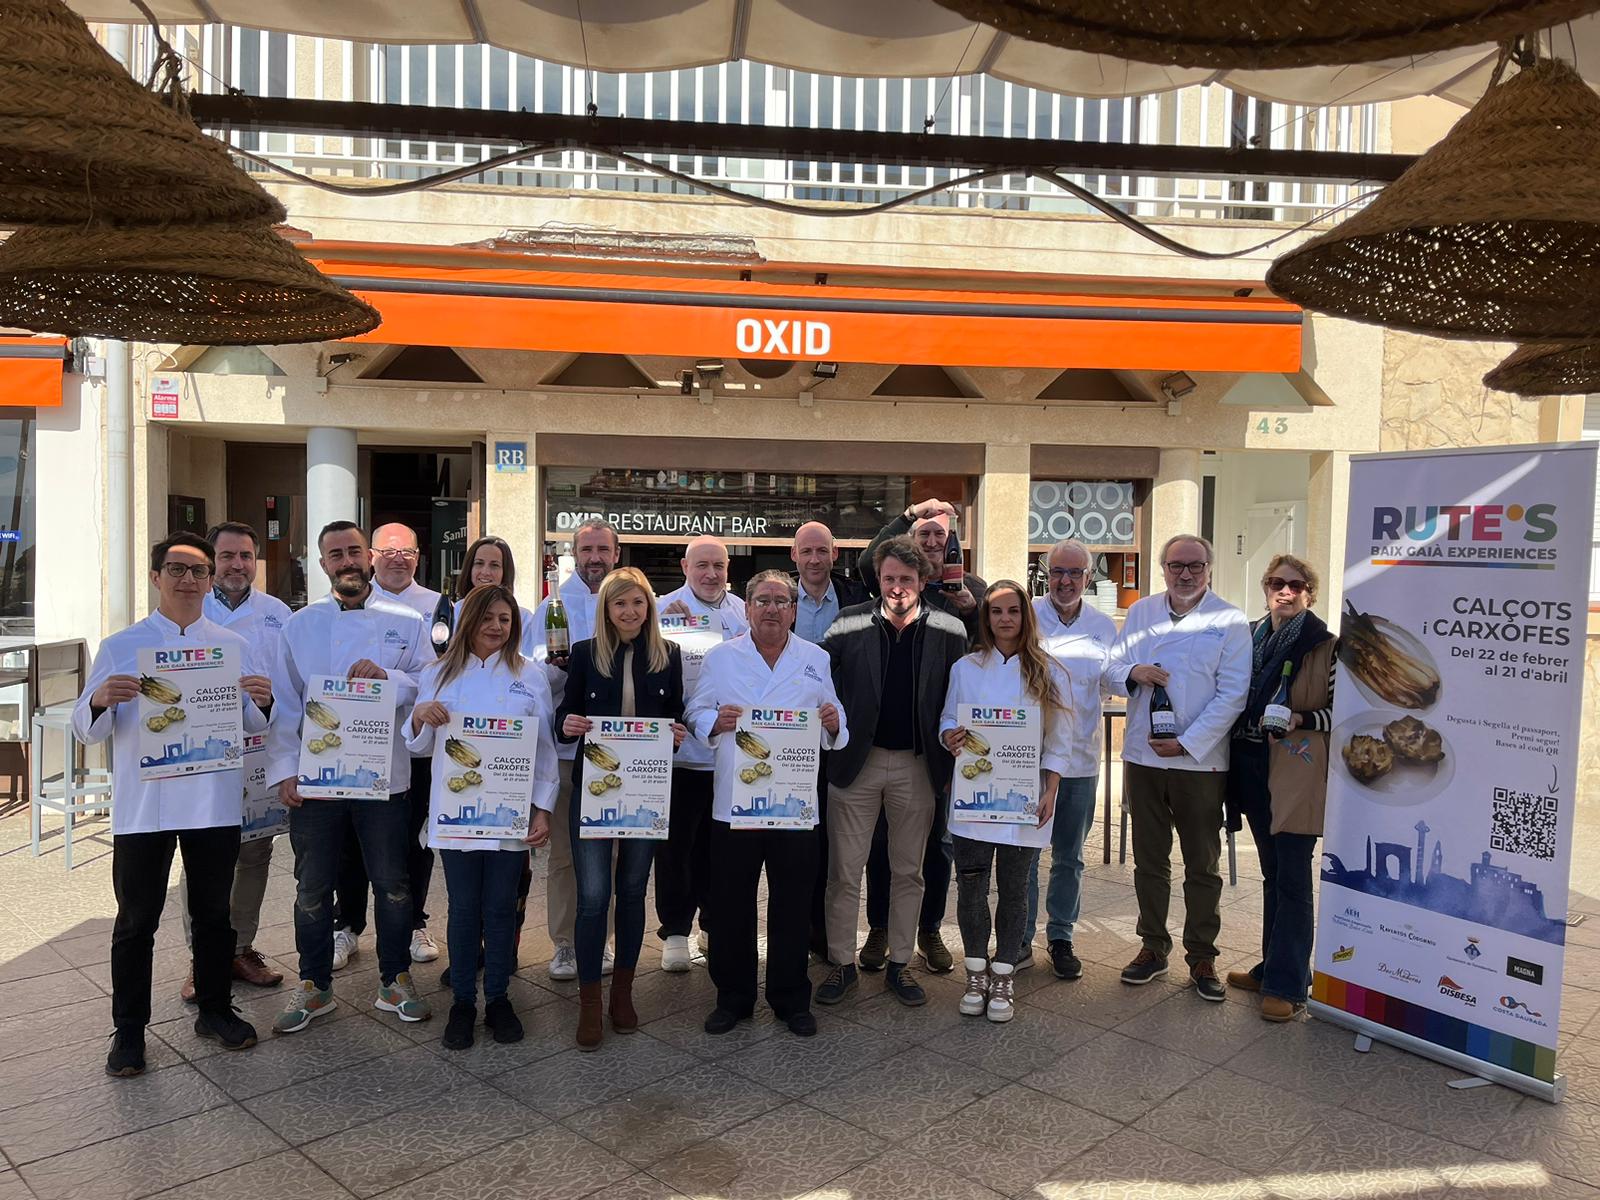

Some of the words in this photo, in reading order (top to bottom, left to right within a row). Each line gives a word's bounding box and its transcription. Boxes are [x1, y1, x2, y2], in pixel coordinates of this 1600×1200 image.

[736, 318, 831, 355] OXID
[1256, 417, 1288, 434] 43
[498, 449, 524, 465] RB
[608, 513, 726, 532] RESTAURANT
[732, 516, 766, 534] BAR
[1370, 546, 1402, 556] BAIX
[1406, 544, 1442, 558] GAIÀ
[1448, 546, 1557, 560] EXPERIENCES
[1452, 597, 1572, 622] CALÇOTS
[1423, 622, 1428, 634] i
[1433, 619, 1570, 646] CARXOFES
[1451, 646, 1474, 658] Del
[1478, 649, 1495, 660] 22
[1500, 650, 1518, 663] de
[1522, 652, 1568, 668] febrer
[1485, 665, 1498, 676] al
[1502, 666, 1516, 678] 21
[1522, 668, 1568, 683] d'abril
[196, 686, 237, 694] CALÇOTS
[353, 720, 390, 728] CALÇOTS
[494, 756, 530, 764] CALÇOTS
[1546, 747, 1558, 756] QR
[1514, 965, 1535, 978] MAGNA
[1440, 987, 1477, 1004] DISBESA
